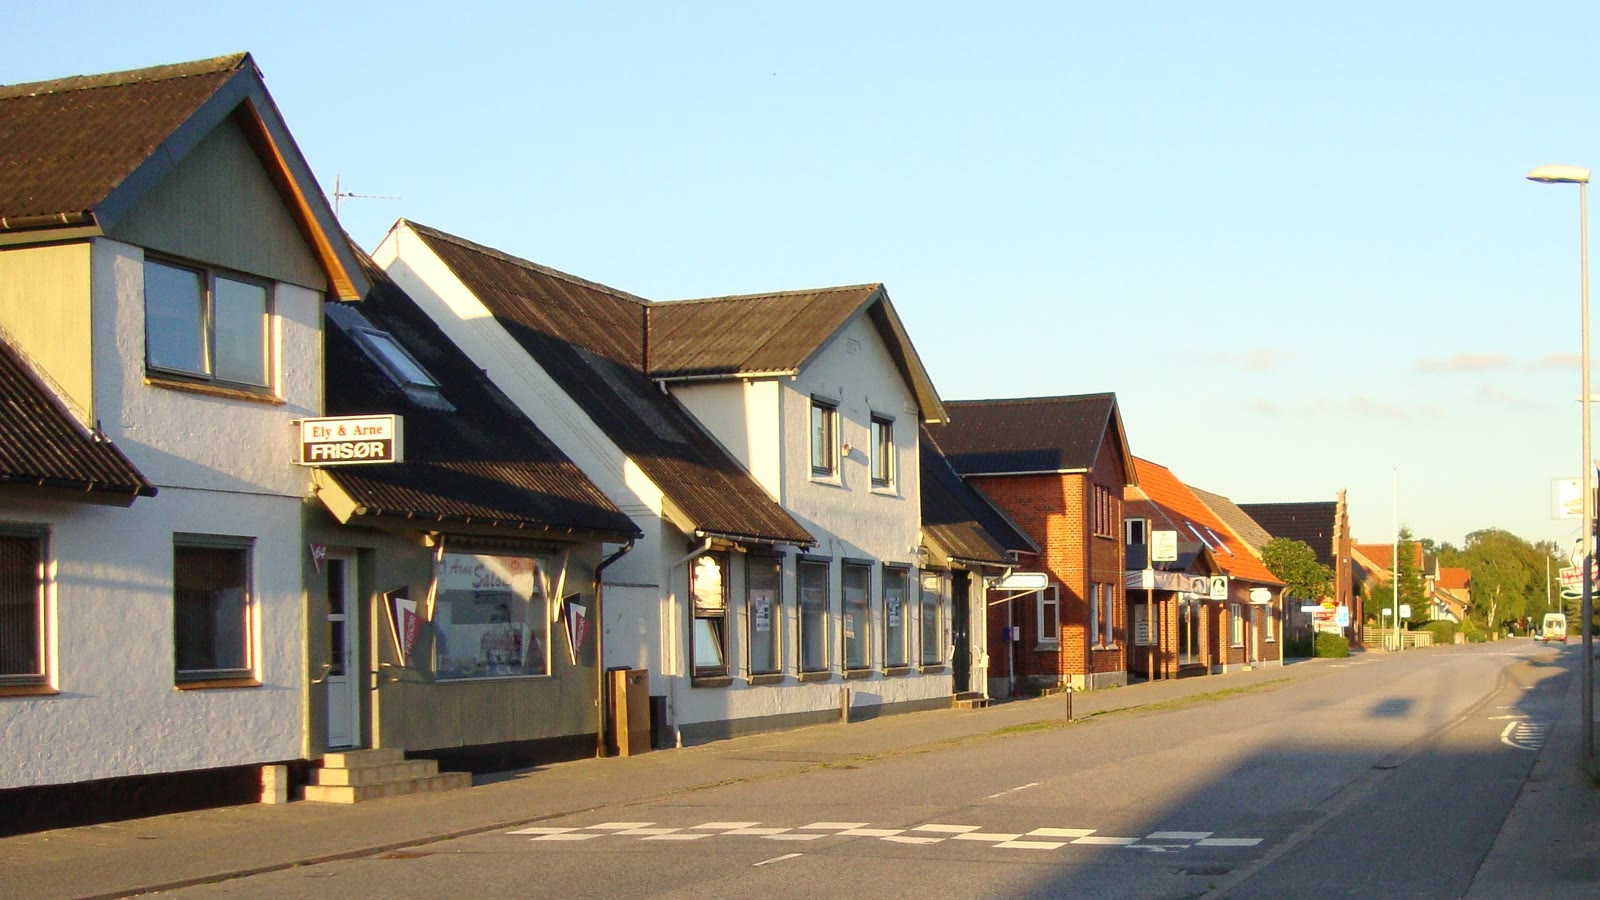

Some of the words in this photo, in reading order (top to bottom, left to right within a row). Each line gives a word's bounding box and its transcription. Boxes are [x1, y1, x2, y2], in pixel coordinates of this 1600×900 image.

[312, 426, 332, 439] Ely
[338, 425, 347, 436] &
[353, 425, 383, 436] Arne
[311, 442, 384, 459] FRISØR
